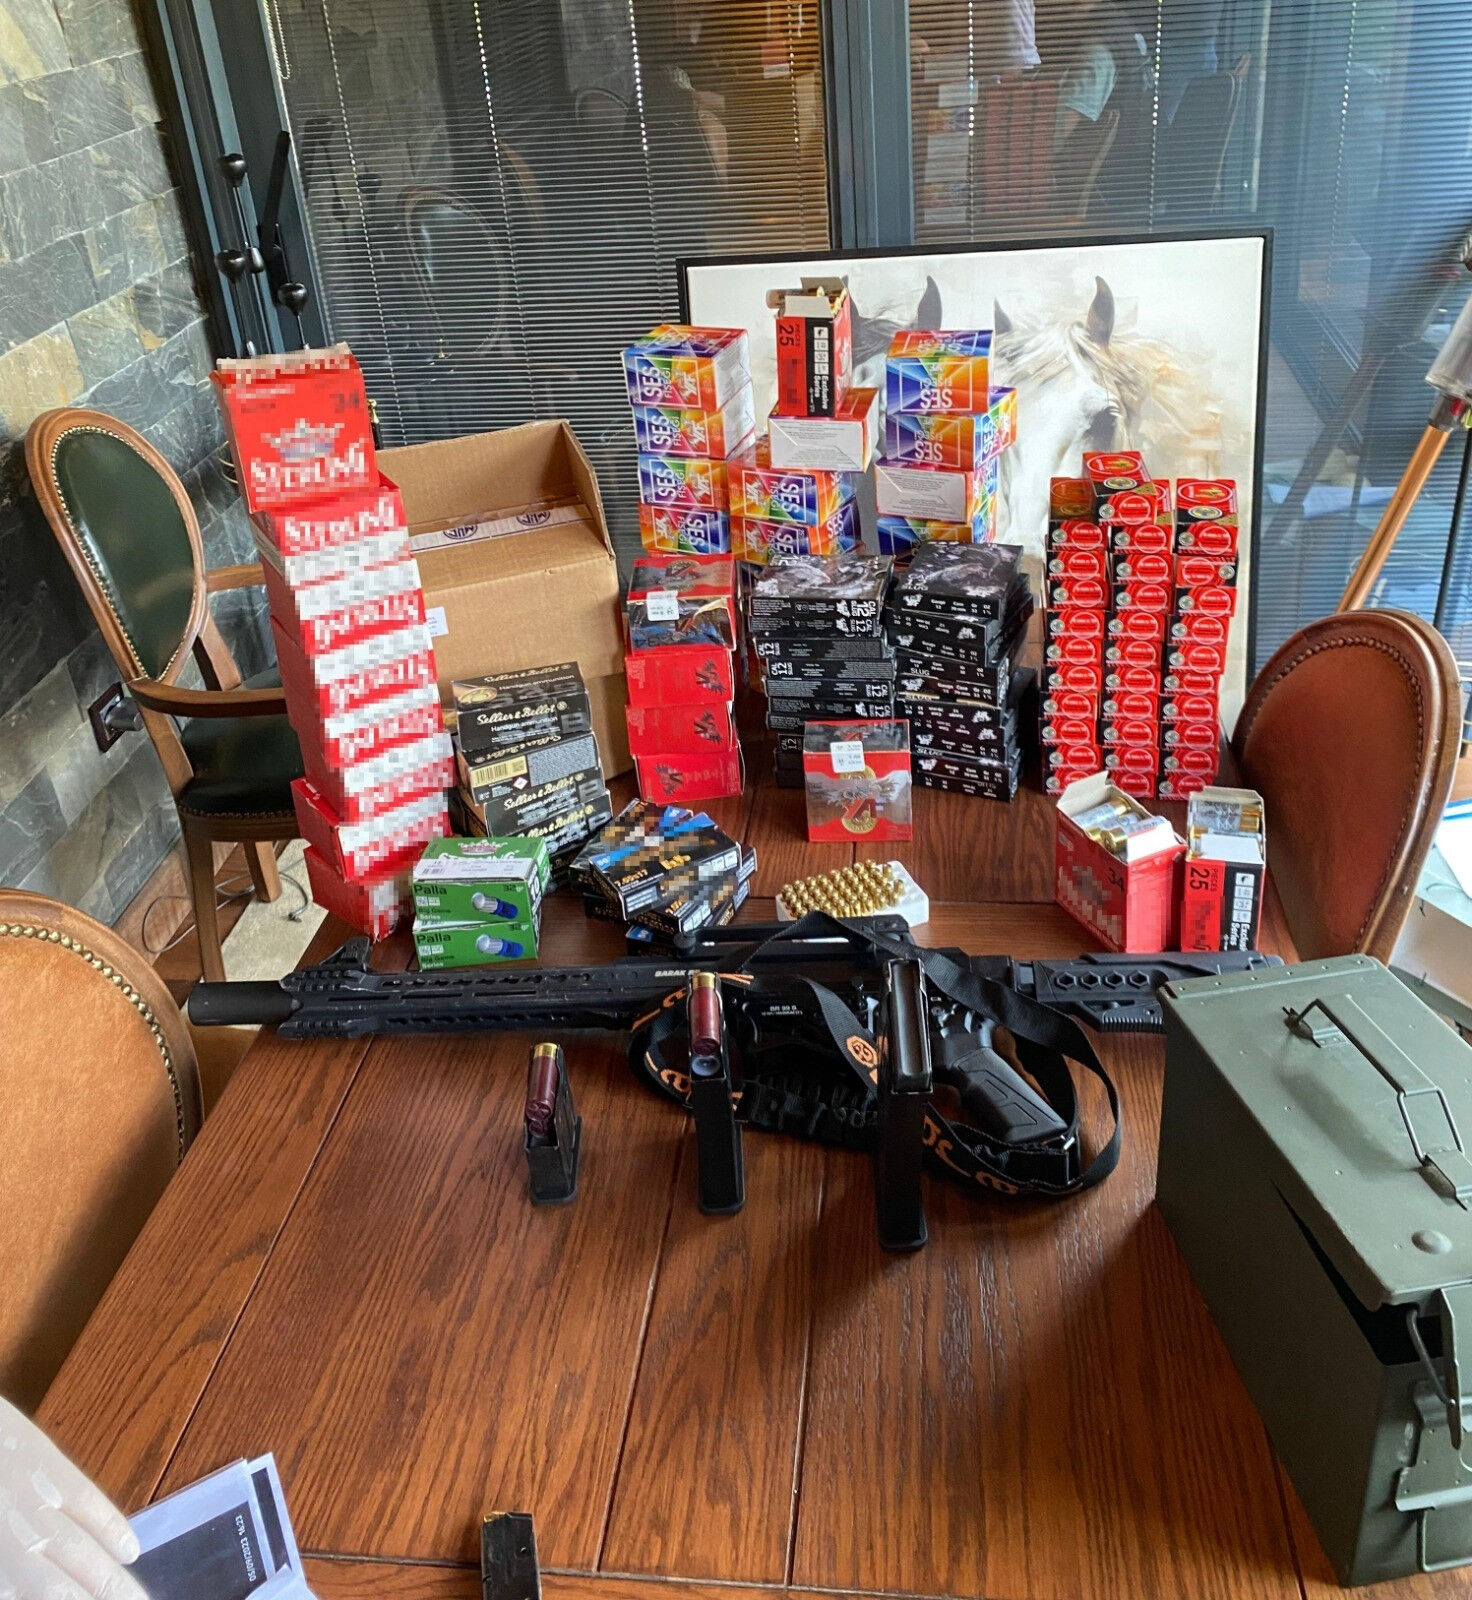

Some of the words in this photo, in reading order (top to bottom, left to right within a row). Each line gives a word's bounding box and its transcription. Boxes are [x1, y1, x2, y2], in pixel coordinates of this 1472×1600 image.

[779, 324, 794, 346] 25
[642, 366, 662, 397] SES
[821, 375, 829, 409] Exclusive
[920, 388, 953, 408] SES
[651, 415, 671, 445] SES
[915, 440, 943, 462] SES
[657, 468, 676, 497] SES
[781, 483, 799, 513] SES
[687, 518, 705, 546] SES
[826, 513, 844, 539] SES
[777, 533, 794, 554] SE
[857, 602, 869, 617] 12
[868, 601, 876, 616] CAL
[856, 620, 866, 632] 12
[765, 643, 774, 655] 12
[778, 662, 788, 675] 12
[910, 667, 930, 676] SLUG
[872, 685, 881, 697] 12
[476, 712, 514, 725] Sellier
[521, 704, 556, 718] Bellot
[875, 705, 884, 717] 12
[491, 721, 520, 733] Handgun
[520, 716, 558, 728] ammunition
[787, 738, 797, 750] 12
[504, 794, 536, 811] Sellier
[543, 777, 575, 794] Bellot
[555, 809, 585, 826] Bellot
[1107, 867, 1125, 893] 34
[1190, 867, 1210, 891] 25
[414, 884, 448, 896] Palla
[416, 933, 452, 944] Palla
[1230, 922, 1240, 946] Series
[422, 961, 444, 969] Series
[240, 1536, 257, 1582] 05/09/2023
